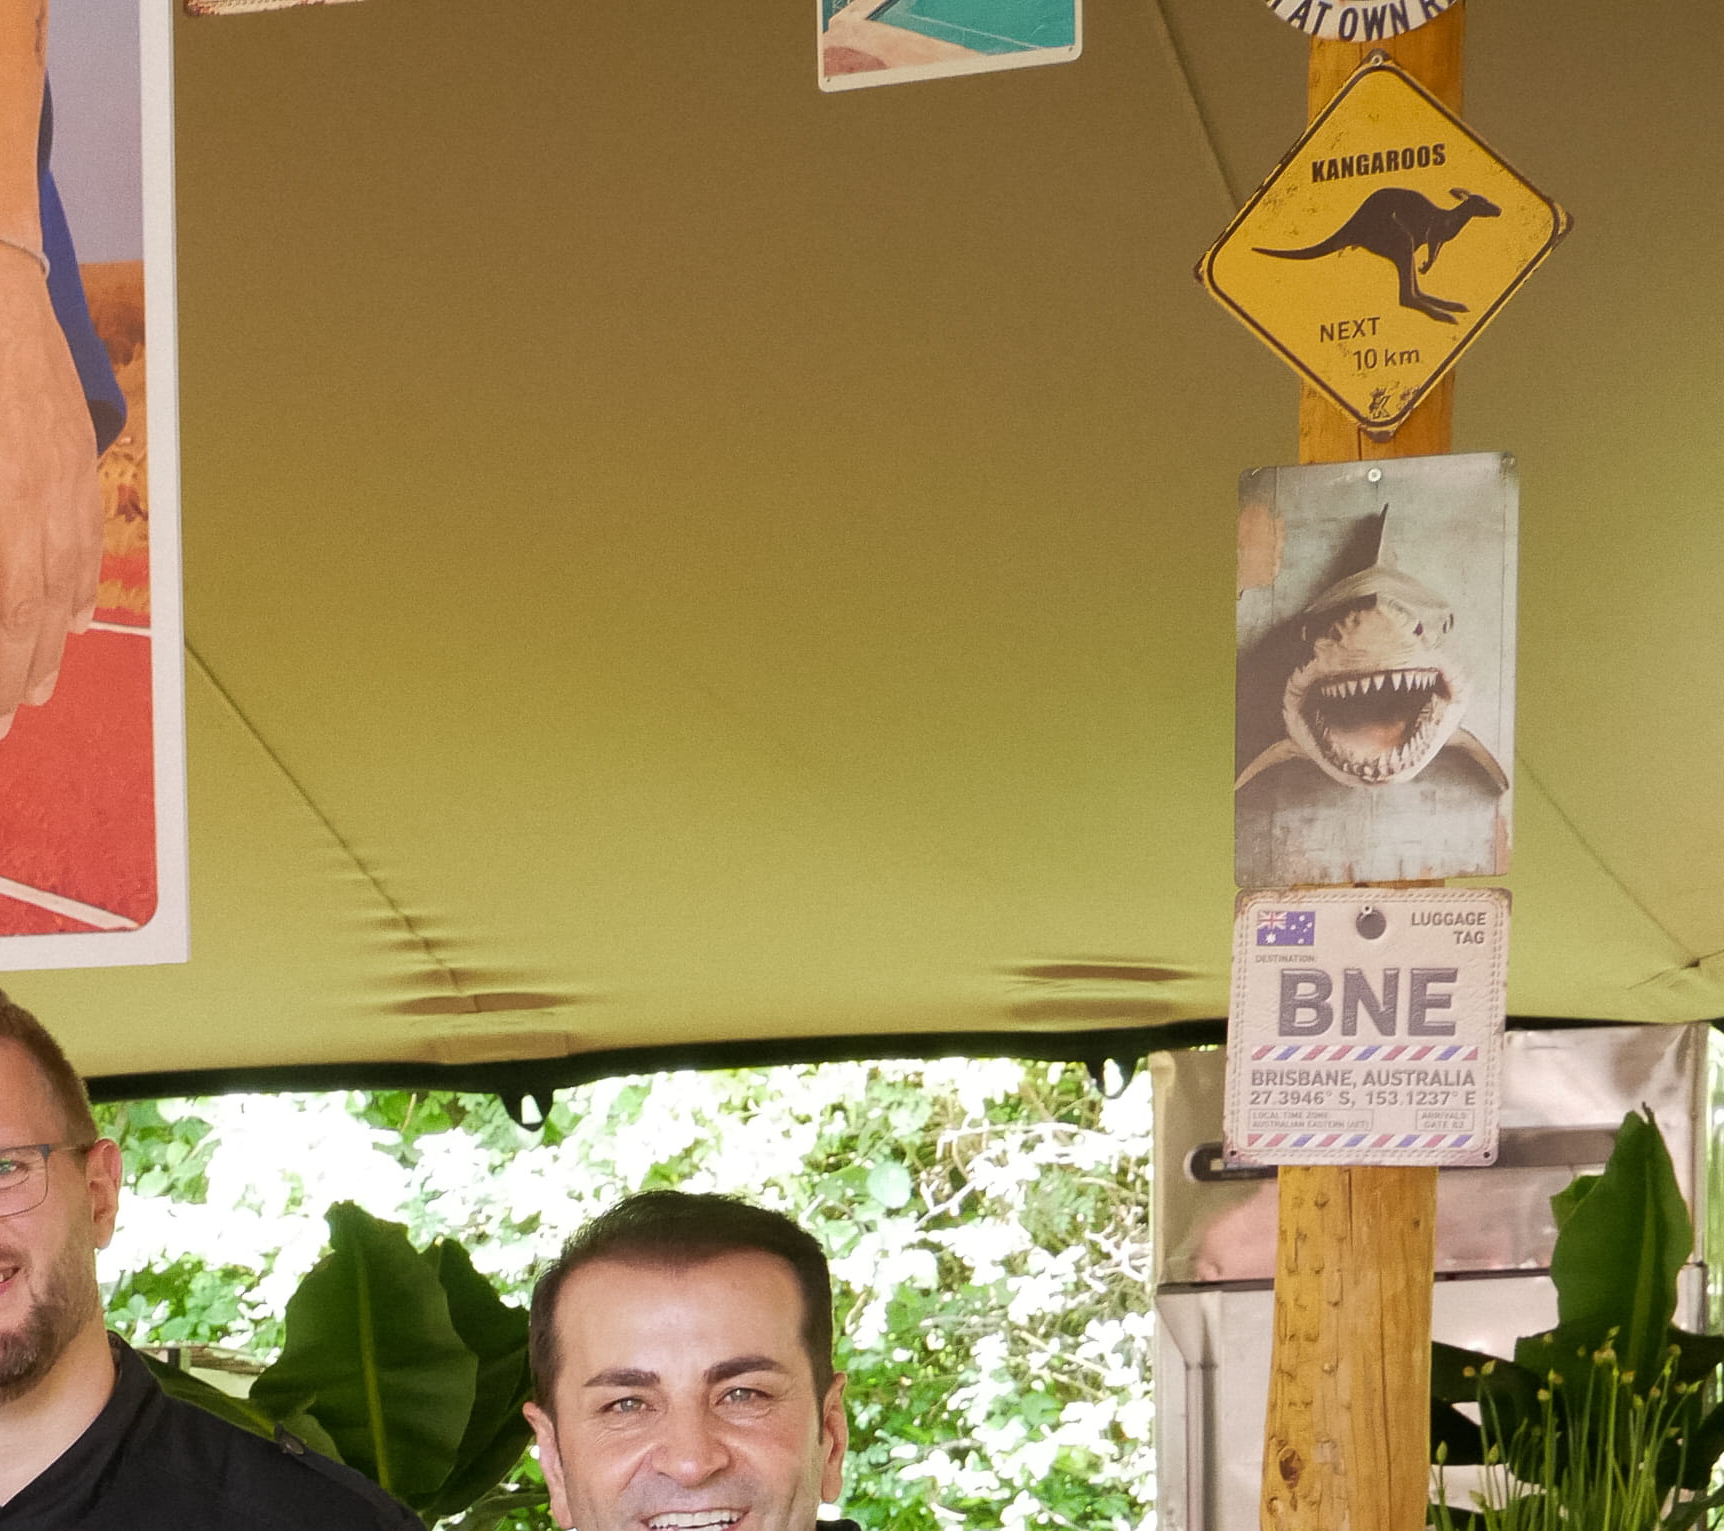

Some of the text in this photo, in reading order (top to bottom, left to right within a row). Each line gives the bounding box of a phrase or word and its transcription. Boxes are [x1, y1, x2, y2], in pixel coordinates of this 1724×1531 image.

[1287, 1, 1332, 36] AT
[1338, 2, 1411, 42] OWN
[1311, 143, 1447, 184] KANGAROOS
[1320, 316, 1381, 343] NEXT
[1353, 348, 1421, 371] 10 km
[1411, 911, 1487, 927] LUGGAGE
[1453, 930, 1485, 945] TAG
[1278, 967, 1459, 1037] BNE
[1251, 1069, 1476, 1089] BRISBANE, AUSTRALIA
[1464, 1090, 1476, 1106] E
